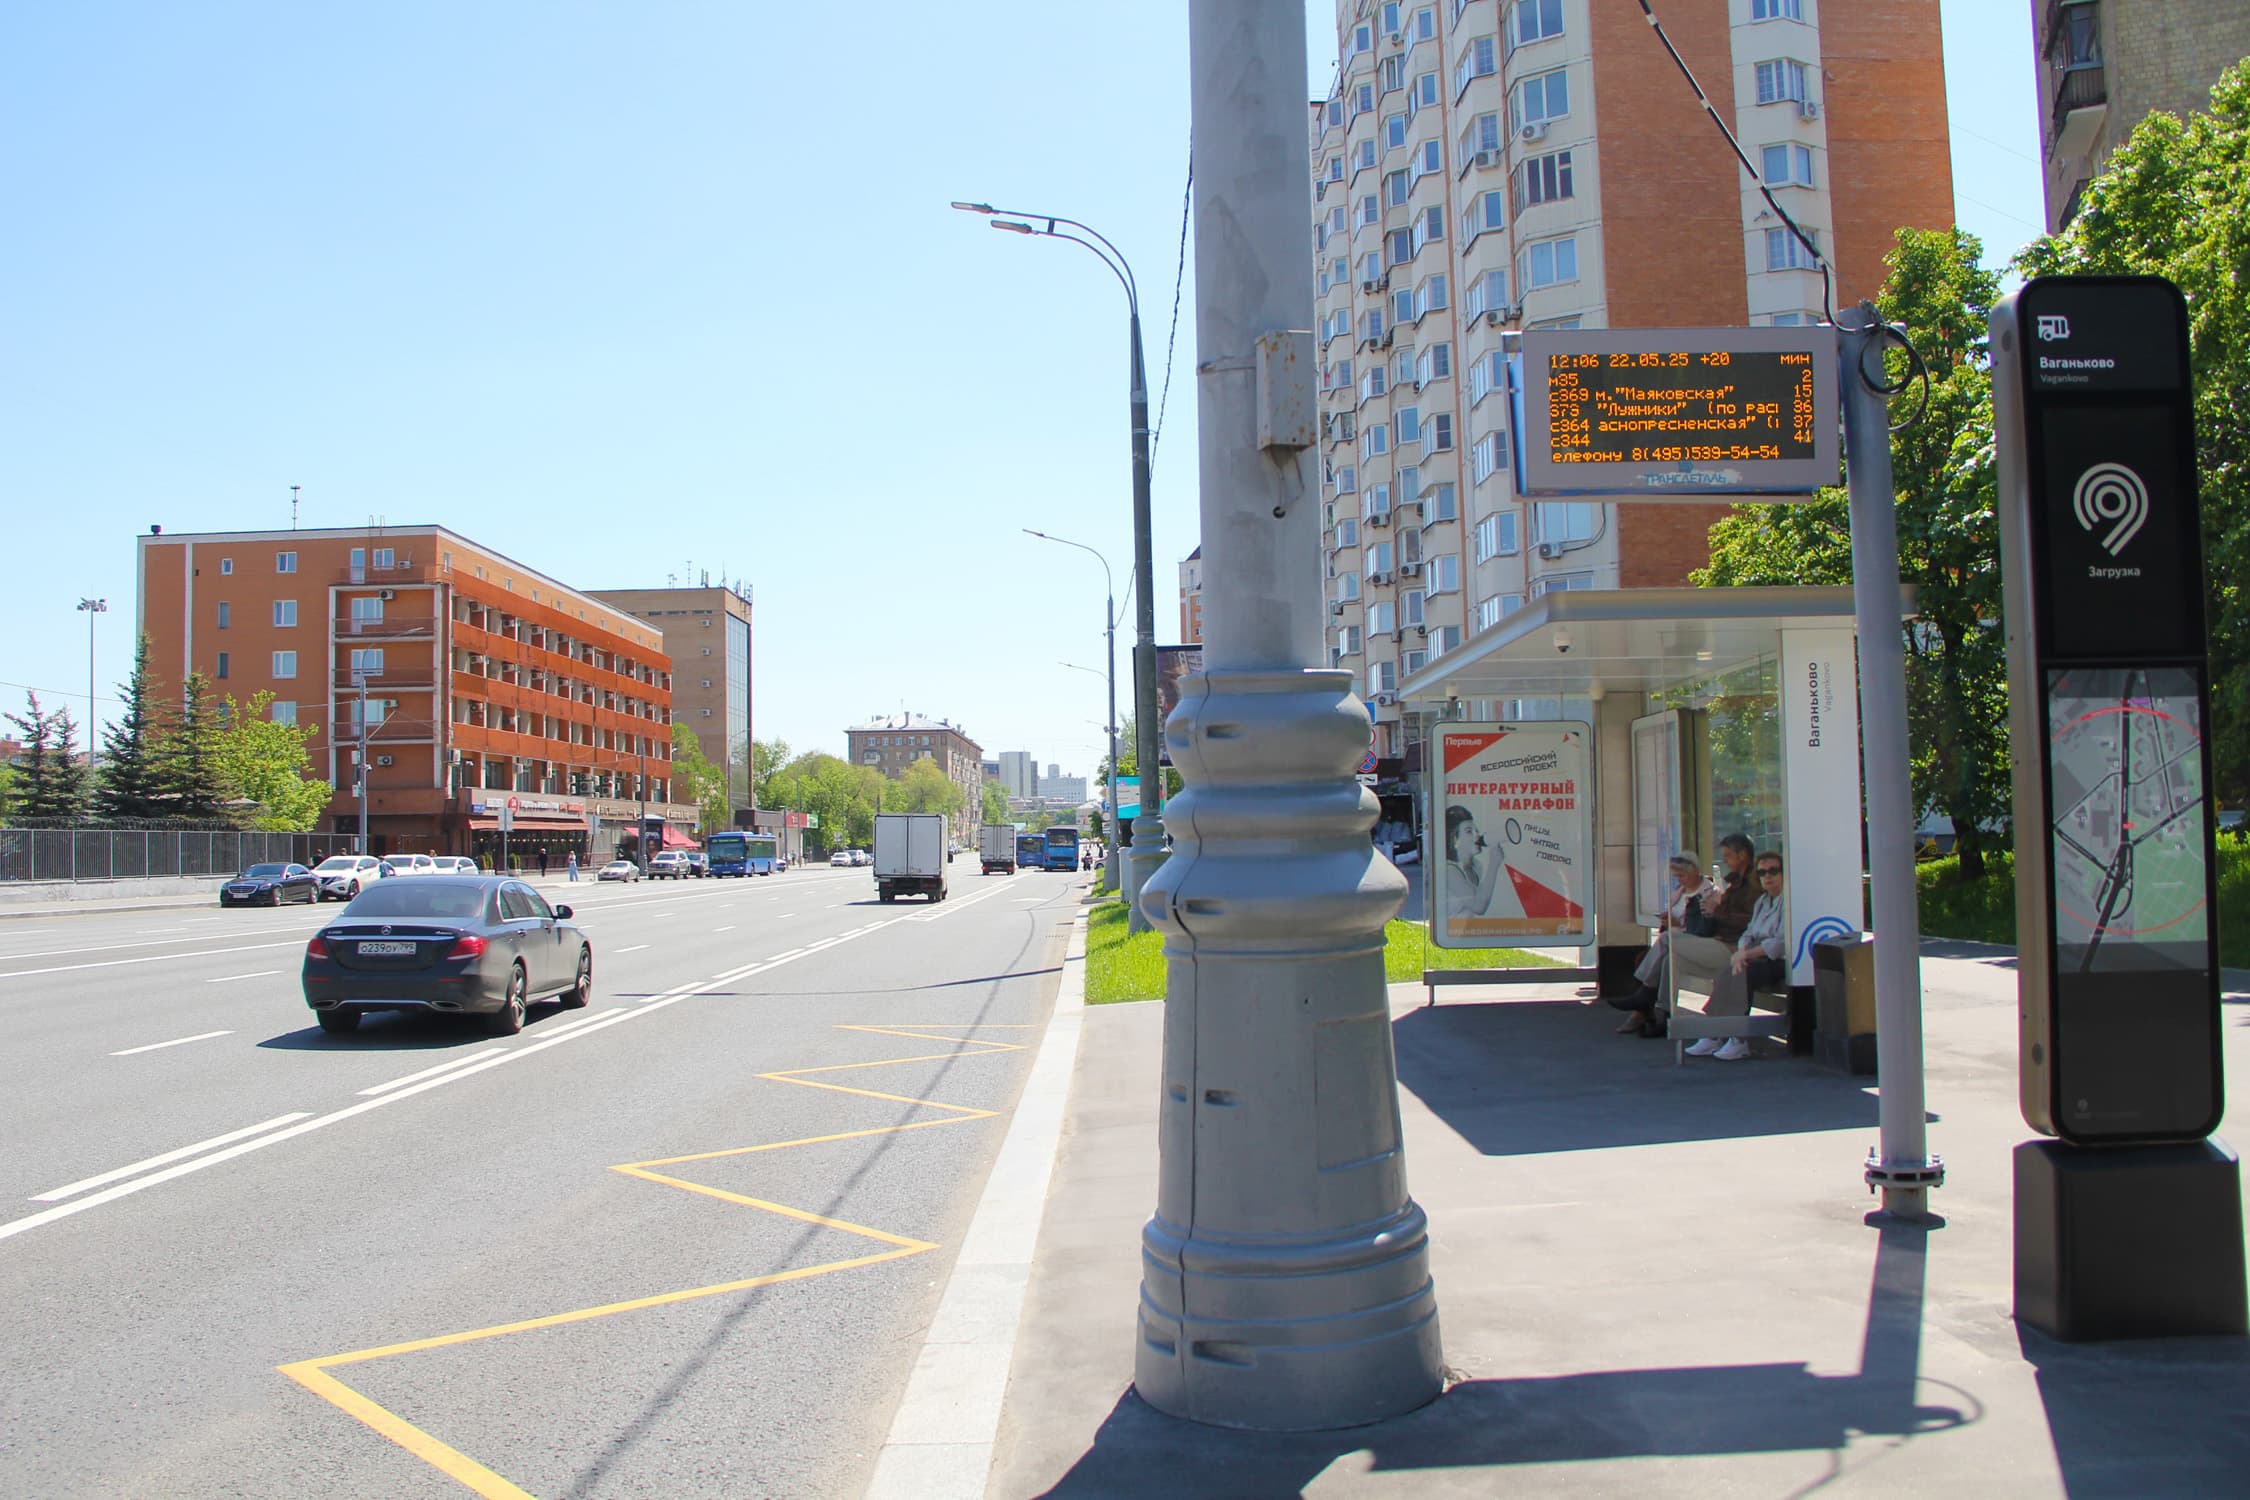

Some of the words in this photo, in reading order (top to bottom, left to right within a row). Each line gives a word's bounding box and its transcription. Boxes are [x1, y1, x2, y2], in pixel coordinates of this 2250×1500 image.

[1551, 354, 1600, 369] 12:06
[1608, 352, 1689, 367] 22.05.25
[1700, 352, 1731, 366] +20
[2040, 356, 2115, 369] Ваганьково
[1548, 373, 1579, 387] м35
[1801, 369, 1812, 383] 2
[2040, 374, 2089, 384] Vagankovo
[1549, 387, 1589, 402] с369
[1794, 384, 1812, 398] 15
[1794, 399, 1813, 413] 36
[1550, 418, 1590, 433] с364
[1794, 414, 1813, 428] 37
[1550, 433, 1591, 448] с344
[1793, 429, 1813, 443] 41
[1552, 452, 1623, 463] елефону
[1646, 473, 1727, 484] ТРАНСДЕТАЛЬ
[2088, 566, 2141, 579] Загрузка
[1808, 662, 1820, 747] Ваганьково
[1445, 737, 1482, 747] Первые
[1480, 750, 1557, 772] ВСЕРОССИЙСКИЙ
[1523, 761, 1558, 774] ПРОЕКТ
[1446, 780, 1575, 795] ЛИТЕРАТУРНЫЙ
[1498, 798, 1575, 810] МАРАФОН
